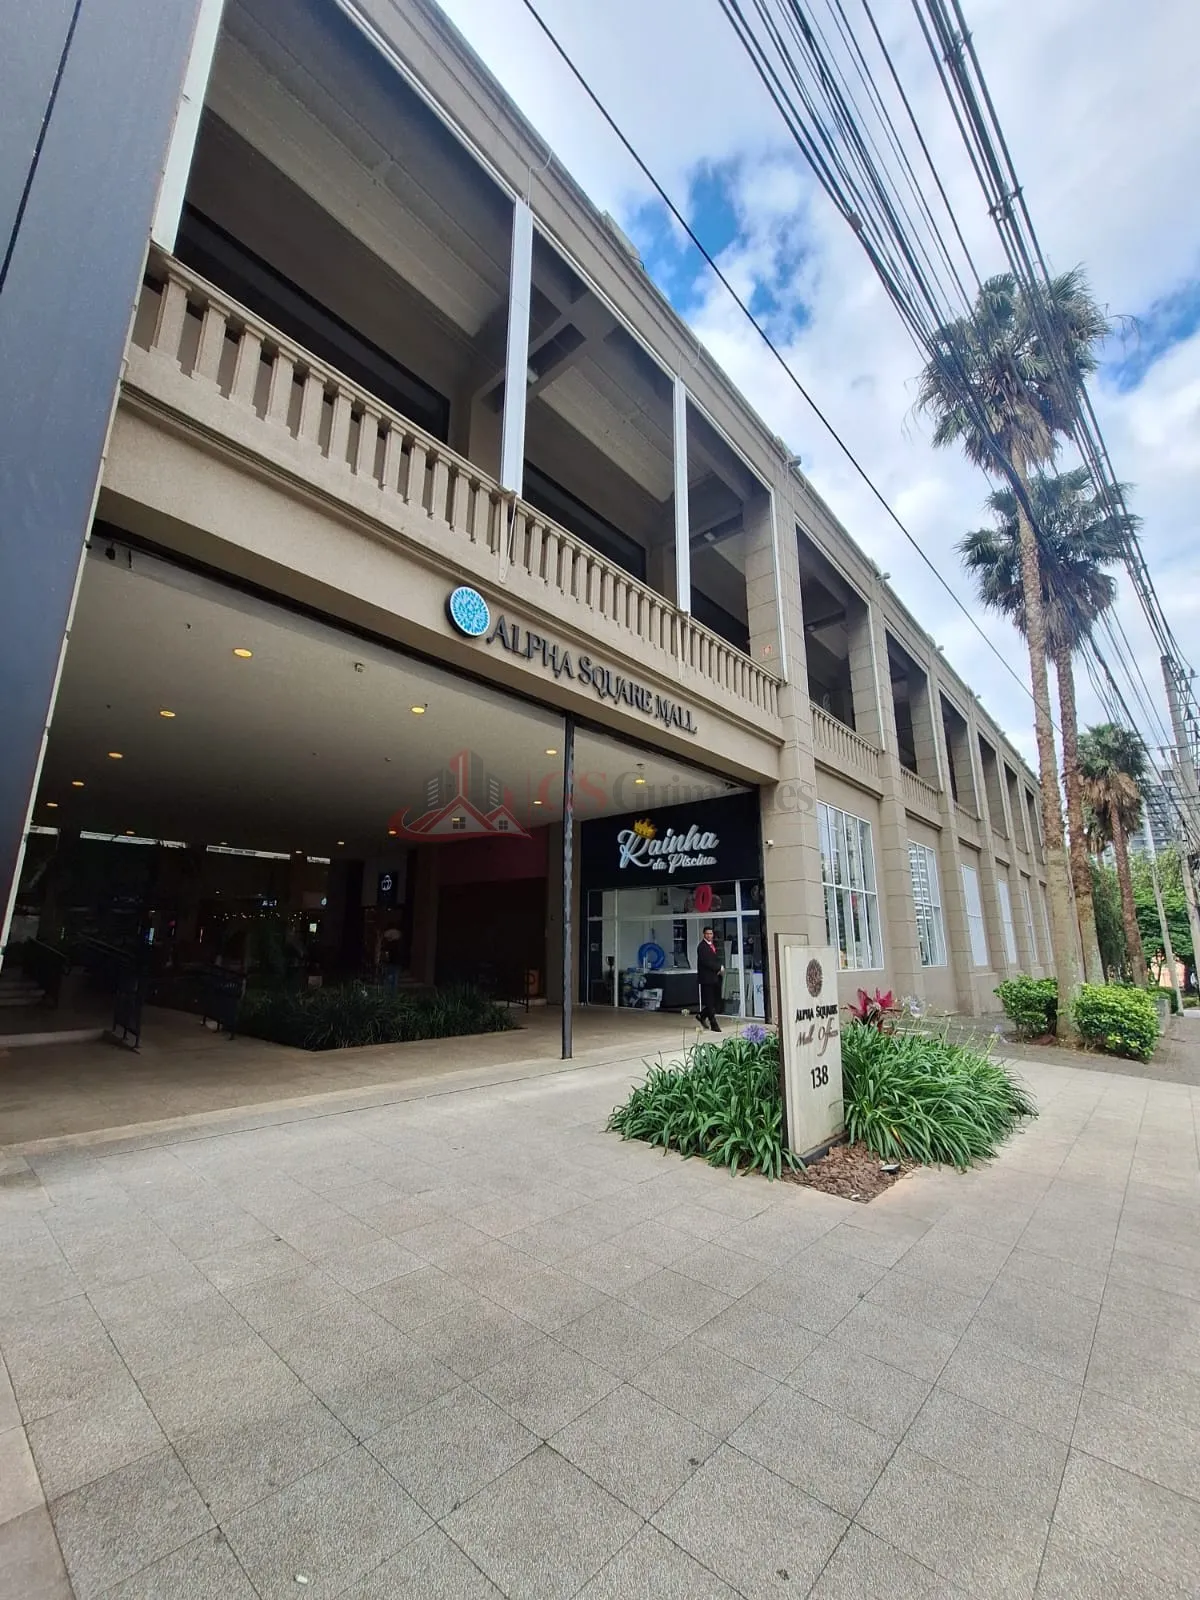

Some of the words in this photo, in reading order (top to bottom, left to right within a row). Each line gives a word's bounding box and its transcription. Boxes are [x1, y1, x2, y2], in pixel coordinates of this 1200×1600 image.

[486, 614, 576, 679] ALPHA
[577, 655, 653, 715] SQUARE
[654, 694, 698, 735] MALL
[617, 823, 720, 869] Rainha
[652, 857, 668, 870] da
[667, 852, 718, 874] Piscina
[795, 1008, 814, 1023] ALPHA
[811, 1064, 829, 1089] 138
